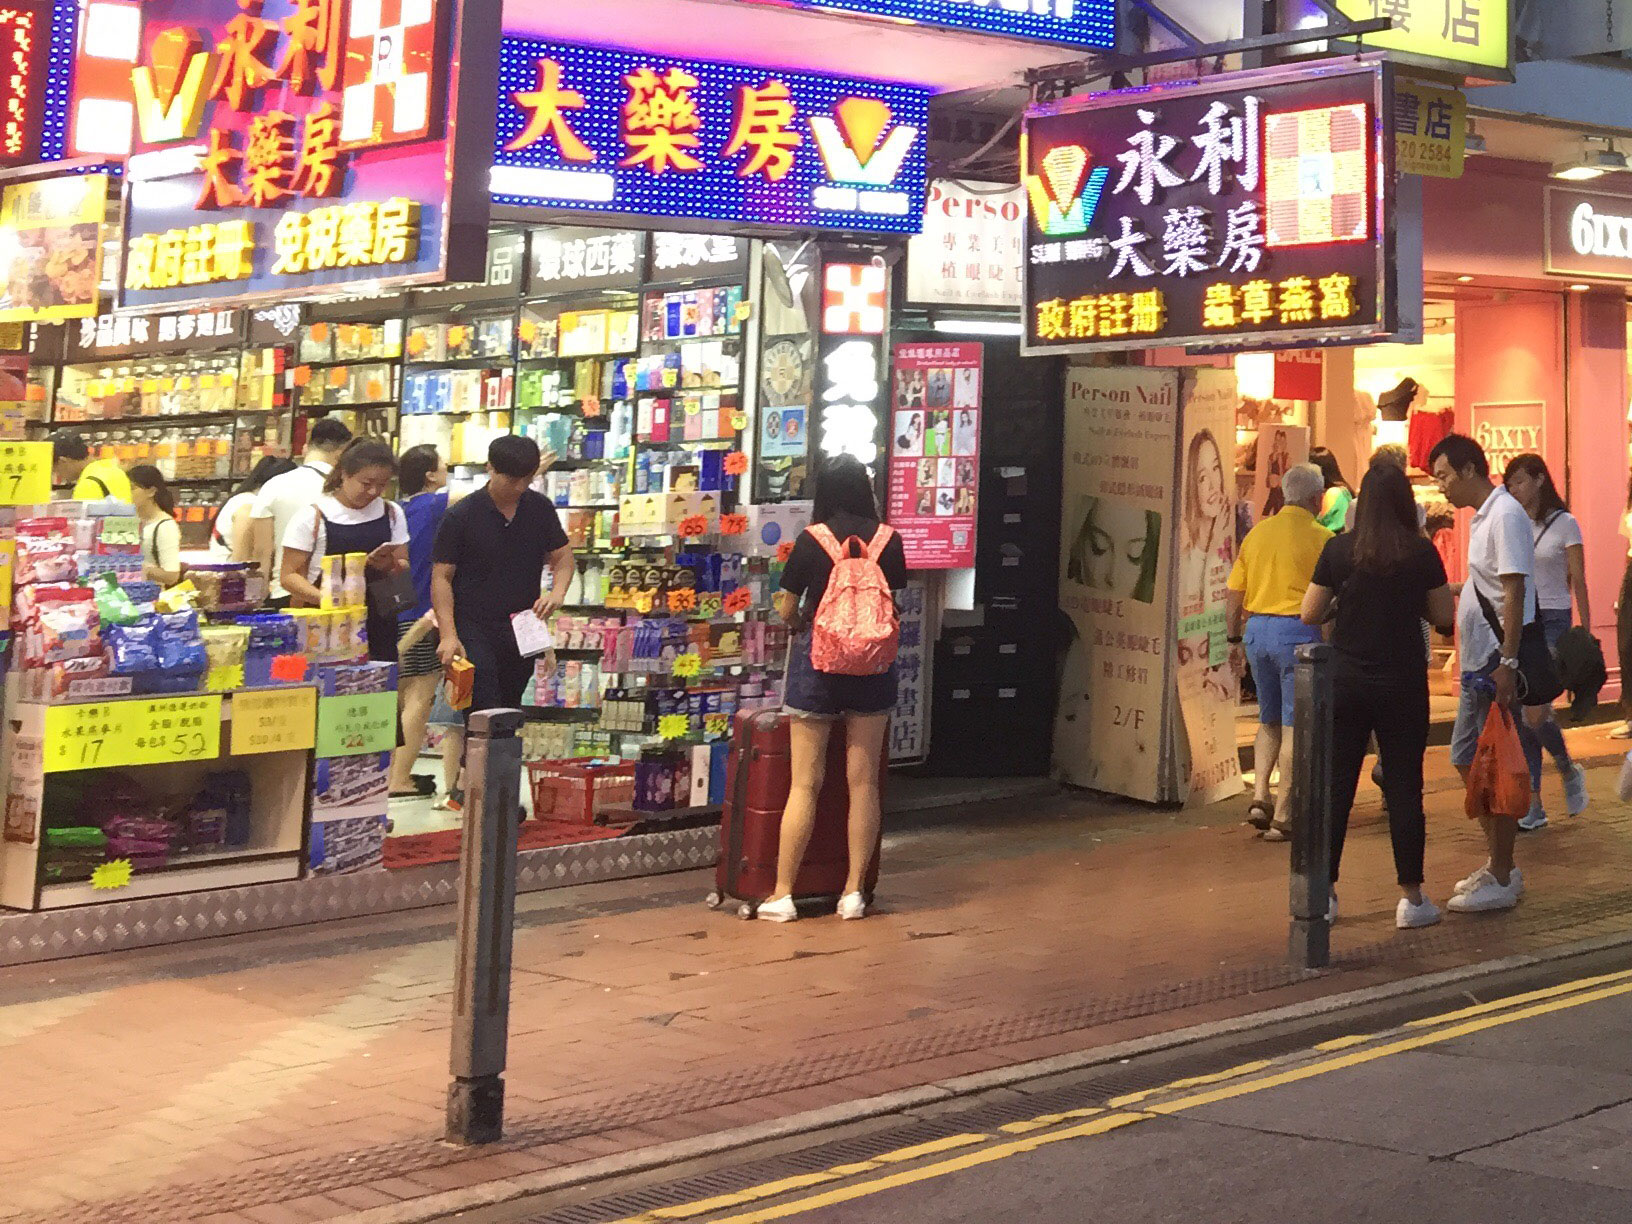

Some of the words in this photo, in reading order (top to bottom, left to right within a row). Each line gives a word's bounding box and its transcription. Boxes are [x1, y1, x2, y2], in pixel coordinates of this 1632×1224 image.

[504, 58, 802, 181] 大藥房
[194, 104, 353, 210] 大藥房
[1113, 95, 1263, 205] 永利
[1109, 200, 1265, 278] 大藥房
[1036, 288, 1165, 339] 政府註冊
[1203, 274, 1357, 328] 蟲草燕窩
[1071, 381, 1130, 403] Person
[1136, 383, 1172, 406] Nail
[170, 733, 207, 756] 52
[1113, 705, 1145, 730] 2/F
